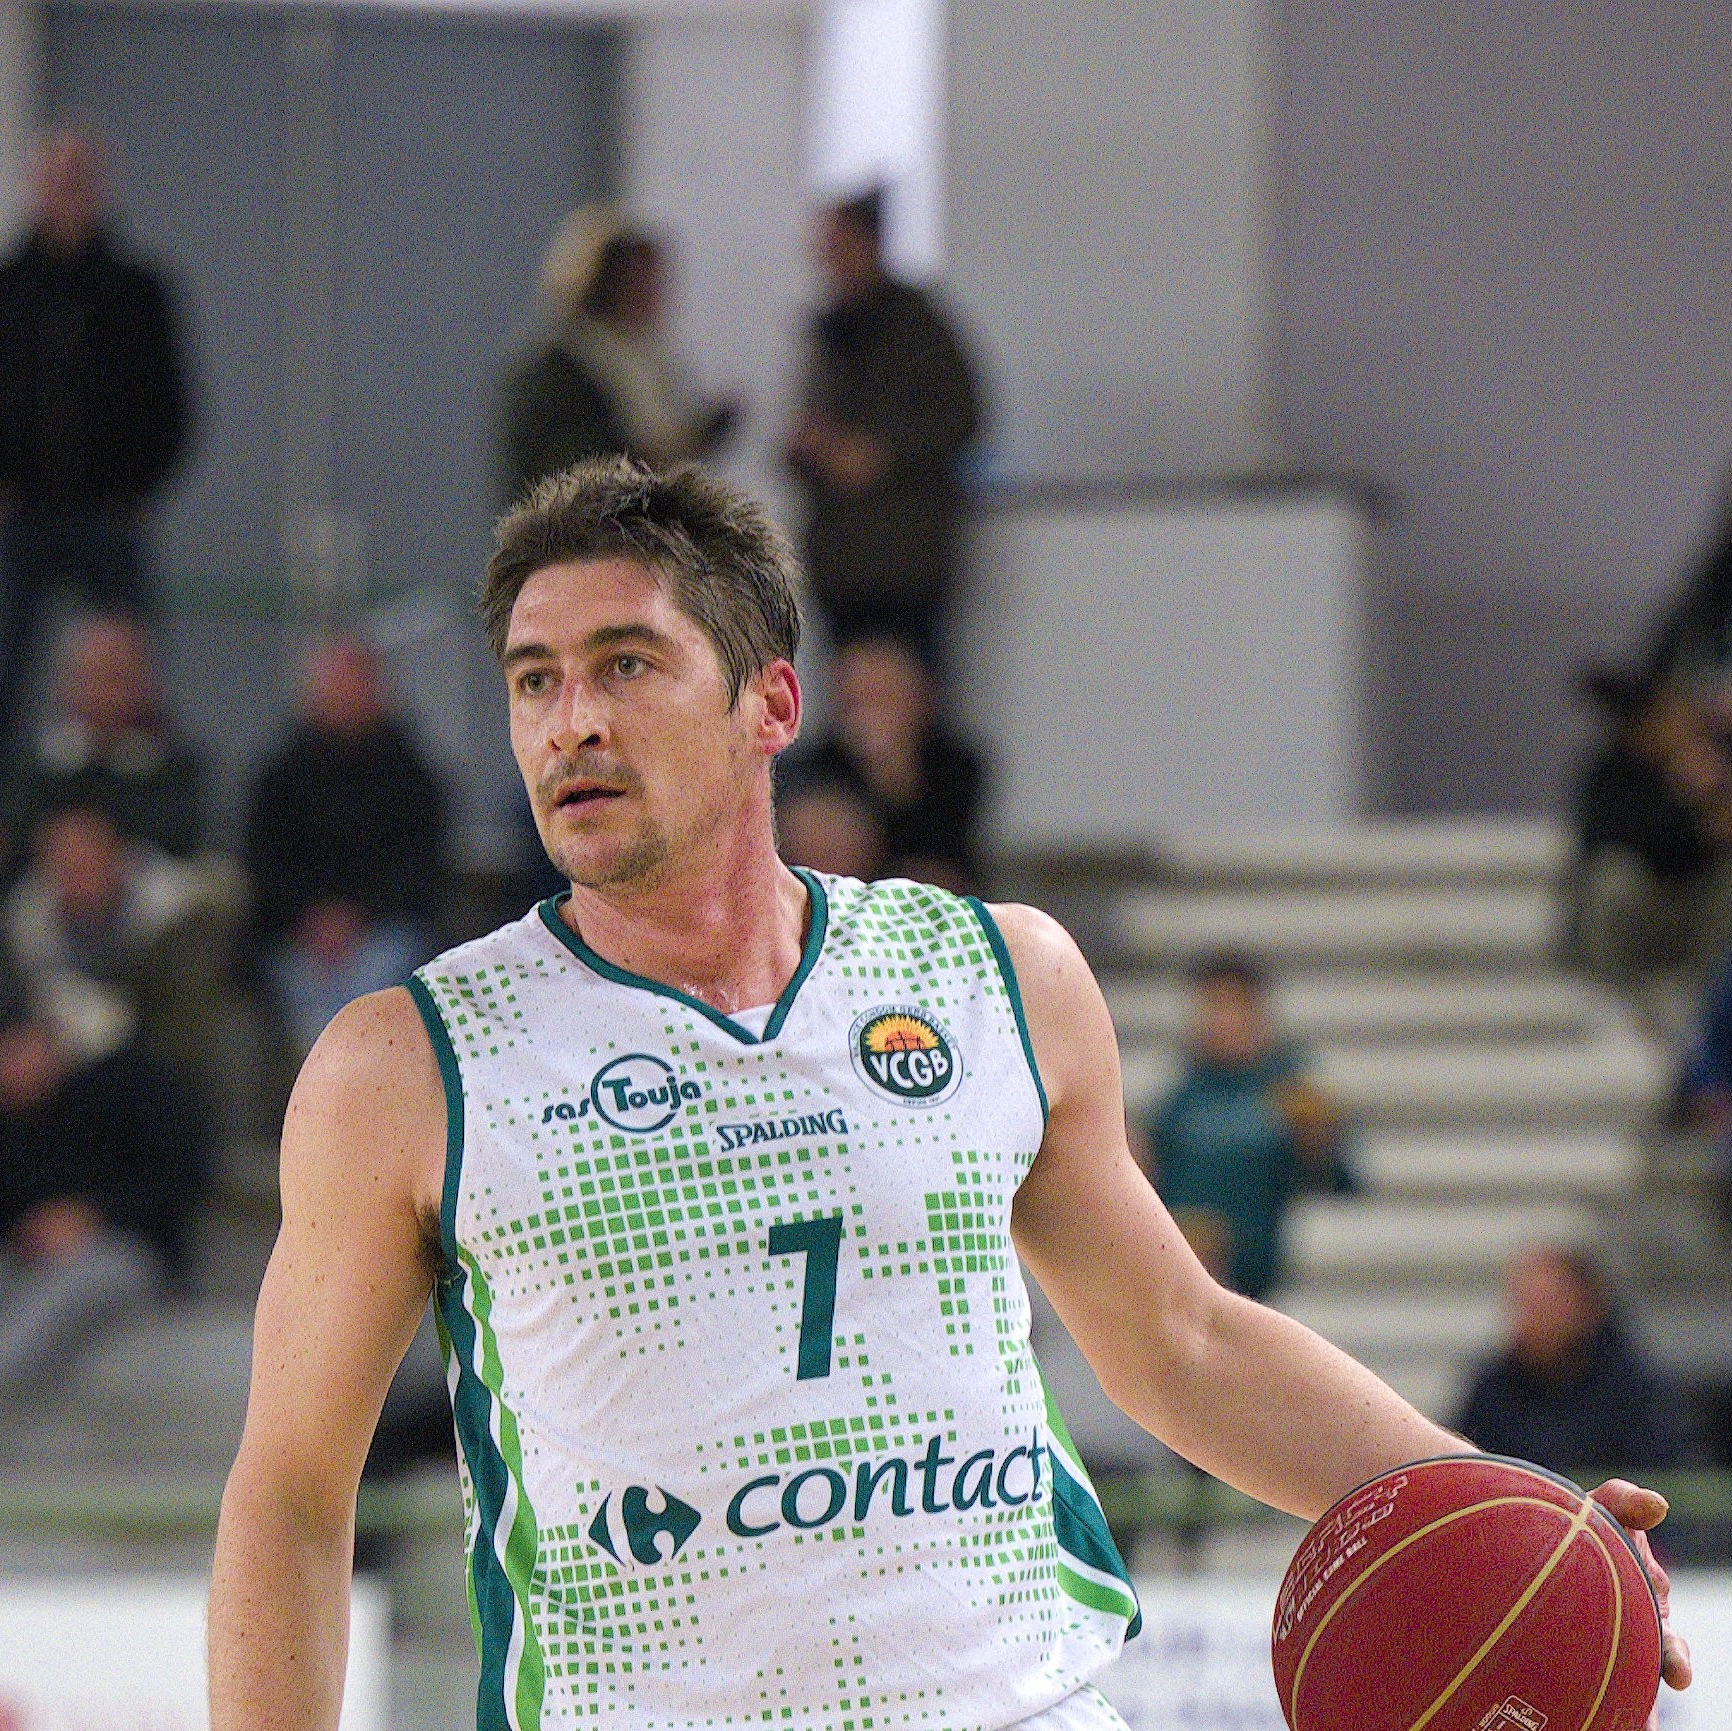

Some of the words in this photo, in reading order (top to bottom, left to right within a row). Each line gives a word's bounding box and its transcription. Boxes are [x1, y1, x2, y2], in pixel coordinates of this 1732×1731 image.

[869, 1048, 949, 1089] VCGB
[541, 1098, 590, 1124] sas
[601, 1075, 702, 1112] Touja
[716, 1108, 849, 1152] SPALDING
[768, 1216, 843, 1381] 7
[726, 1425, 1047, 1538] contact
